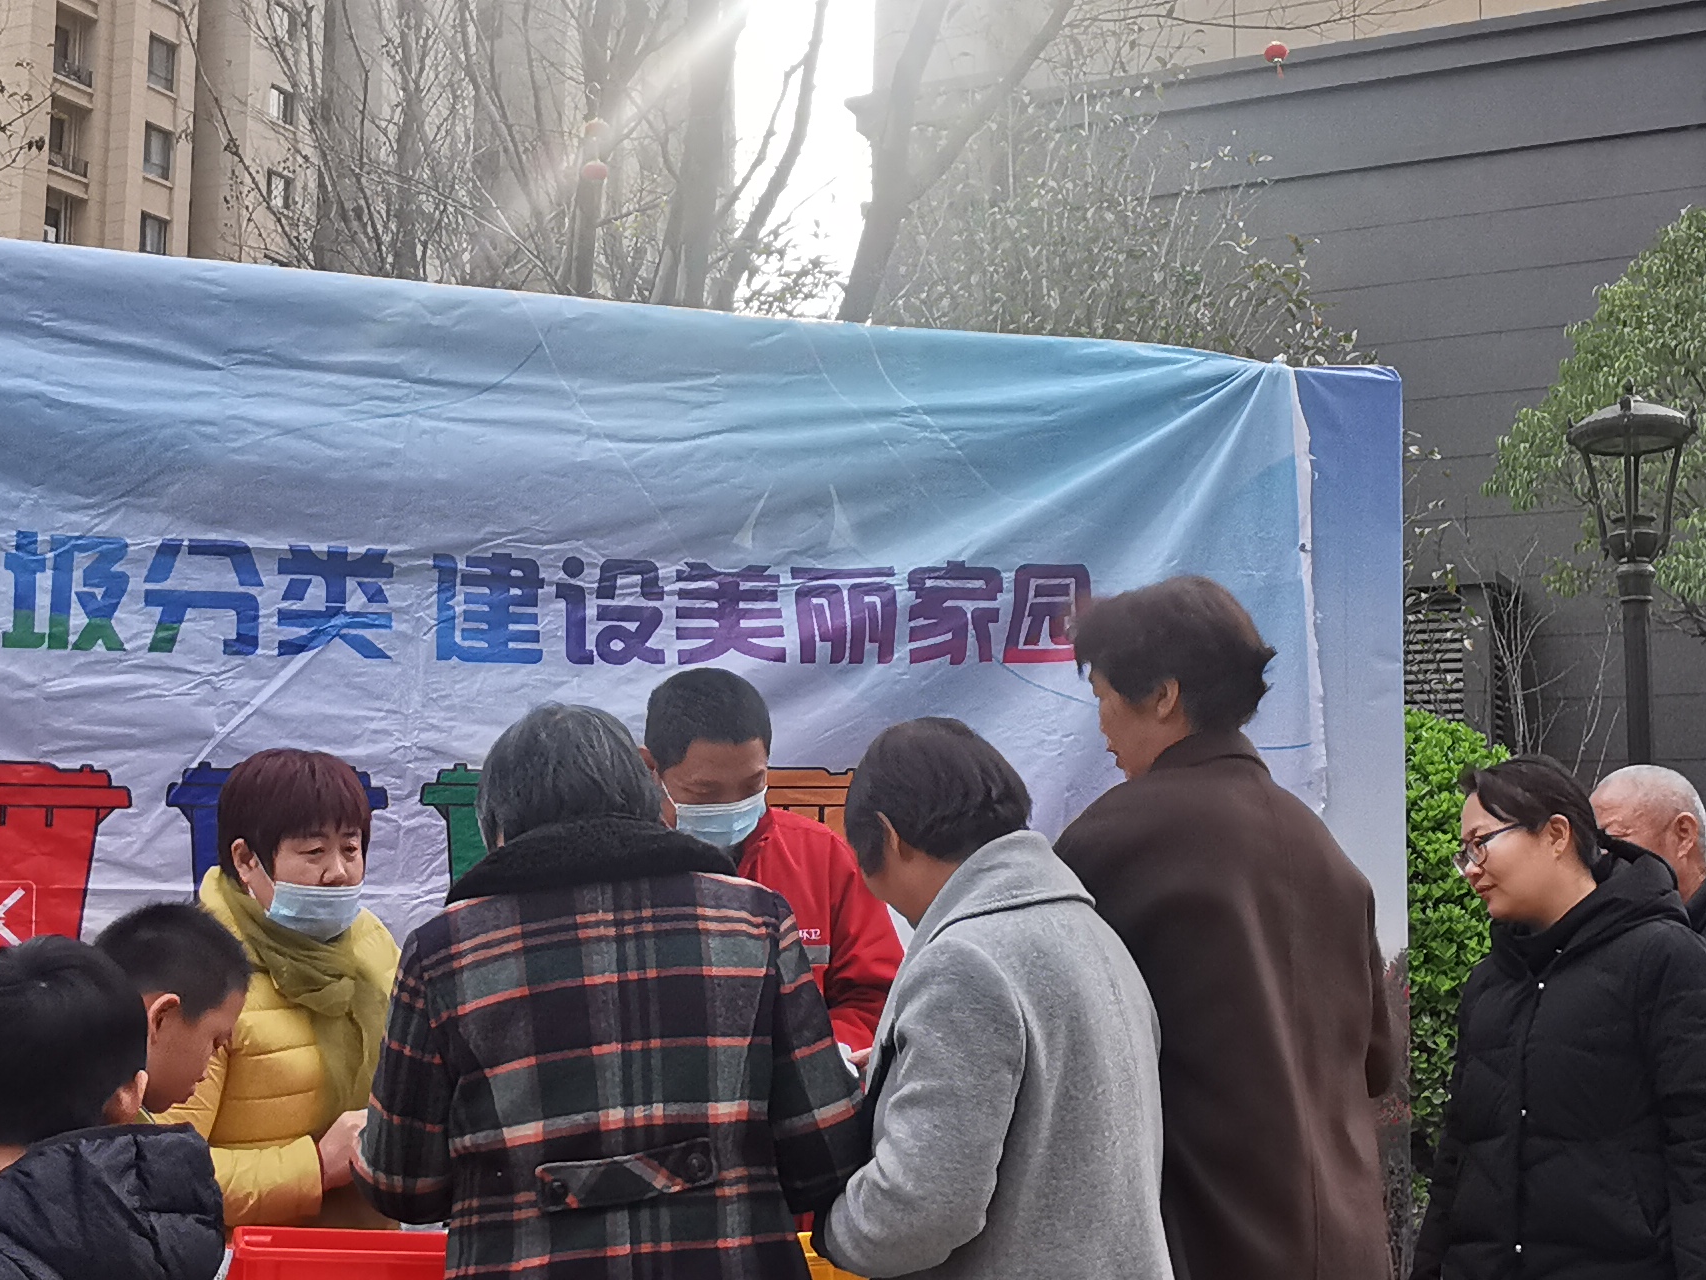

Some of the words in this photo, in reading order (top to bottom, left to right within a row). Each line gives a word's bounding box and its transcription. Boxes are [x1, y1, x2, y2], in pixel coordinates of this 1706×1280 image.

[433, 552, 1090, 666] 建设美丽家园
